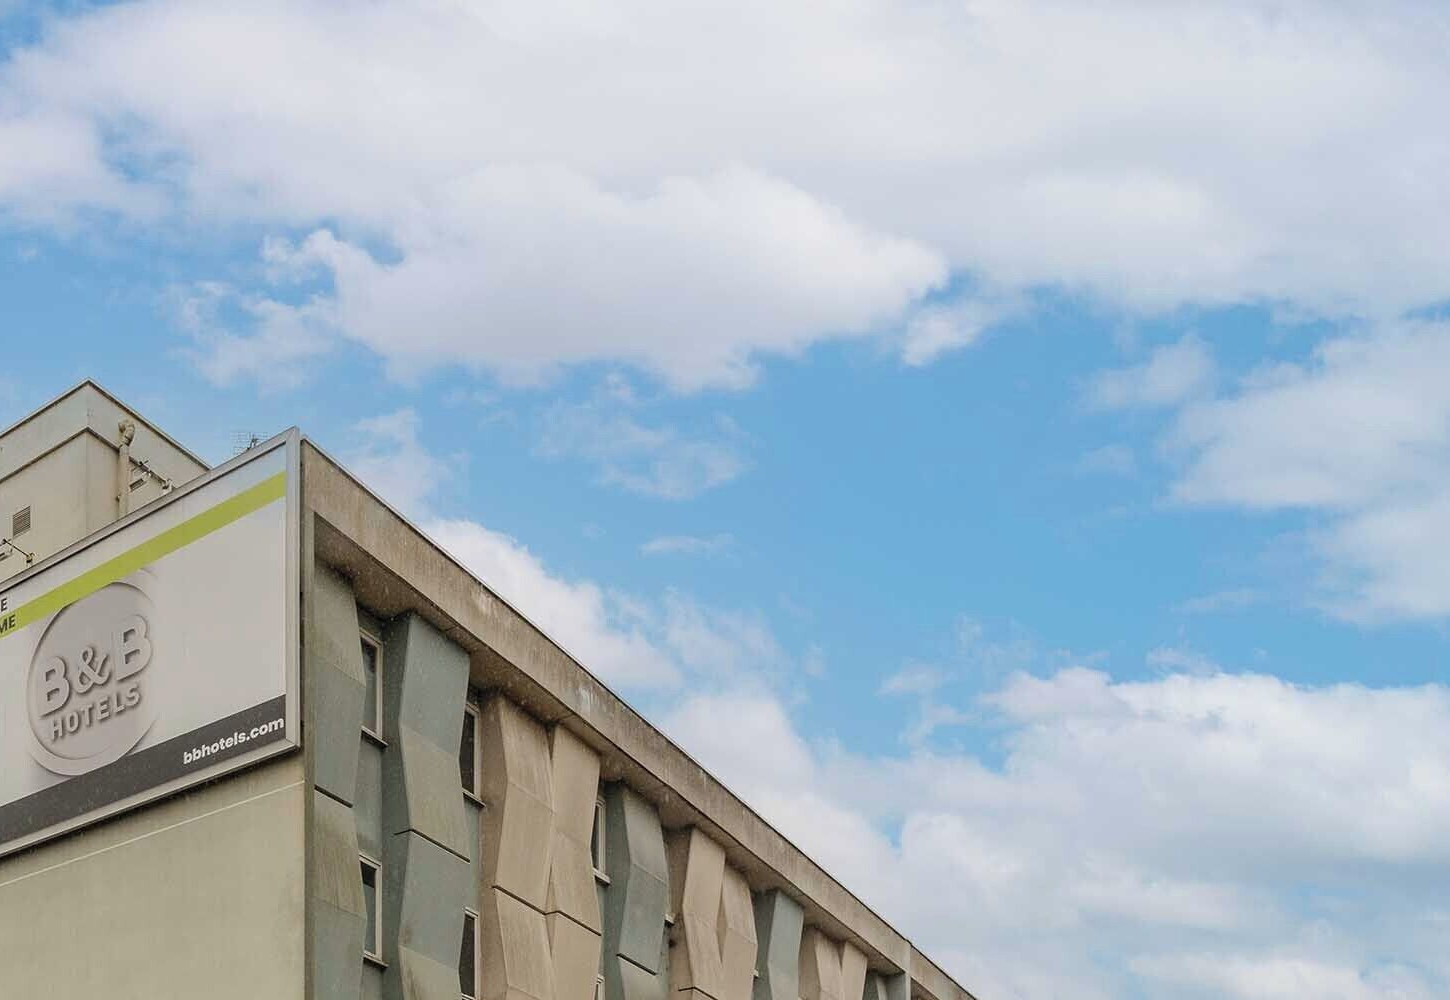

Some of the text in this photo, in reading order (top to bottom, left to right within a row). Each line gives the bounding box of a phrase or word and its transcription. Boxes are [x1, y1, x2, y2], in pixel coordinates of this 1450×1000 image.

[37, 614, 153, 718] B&B
[52, 684, 142, 740] HOTELS
[183, 718, 285, 764] bbhotels.com
